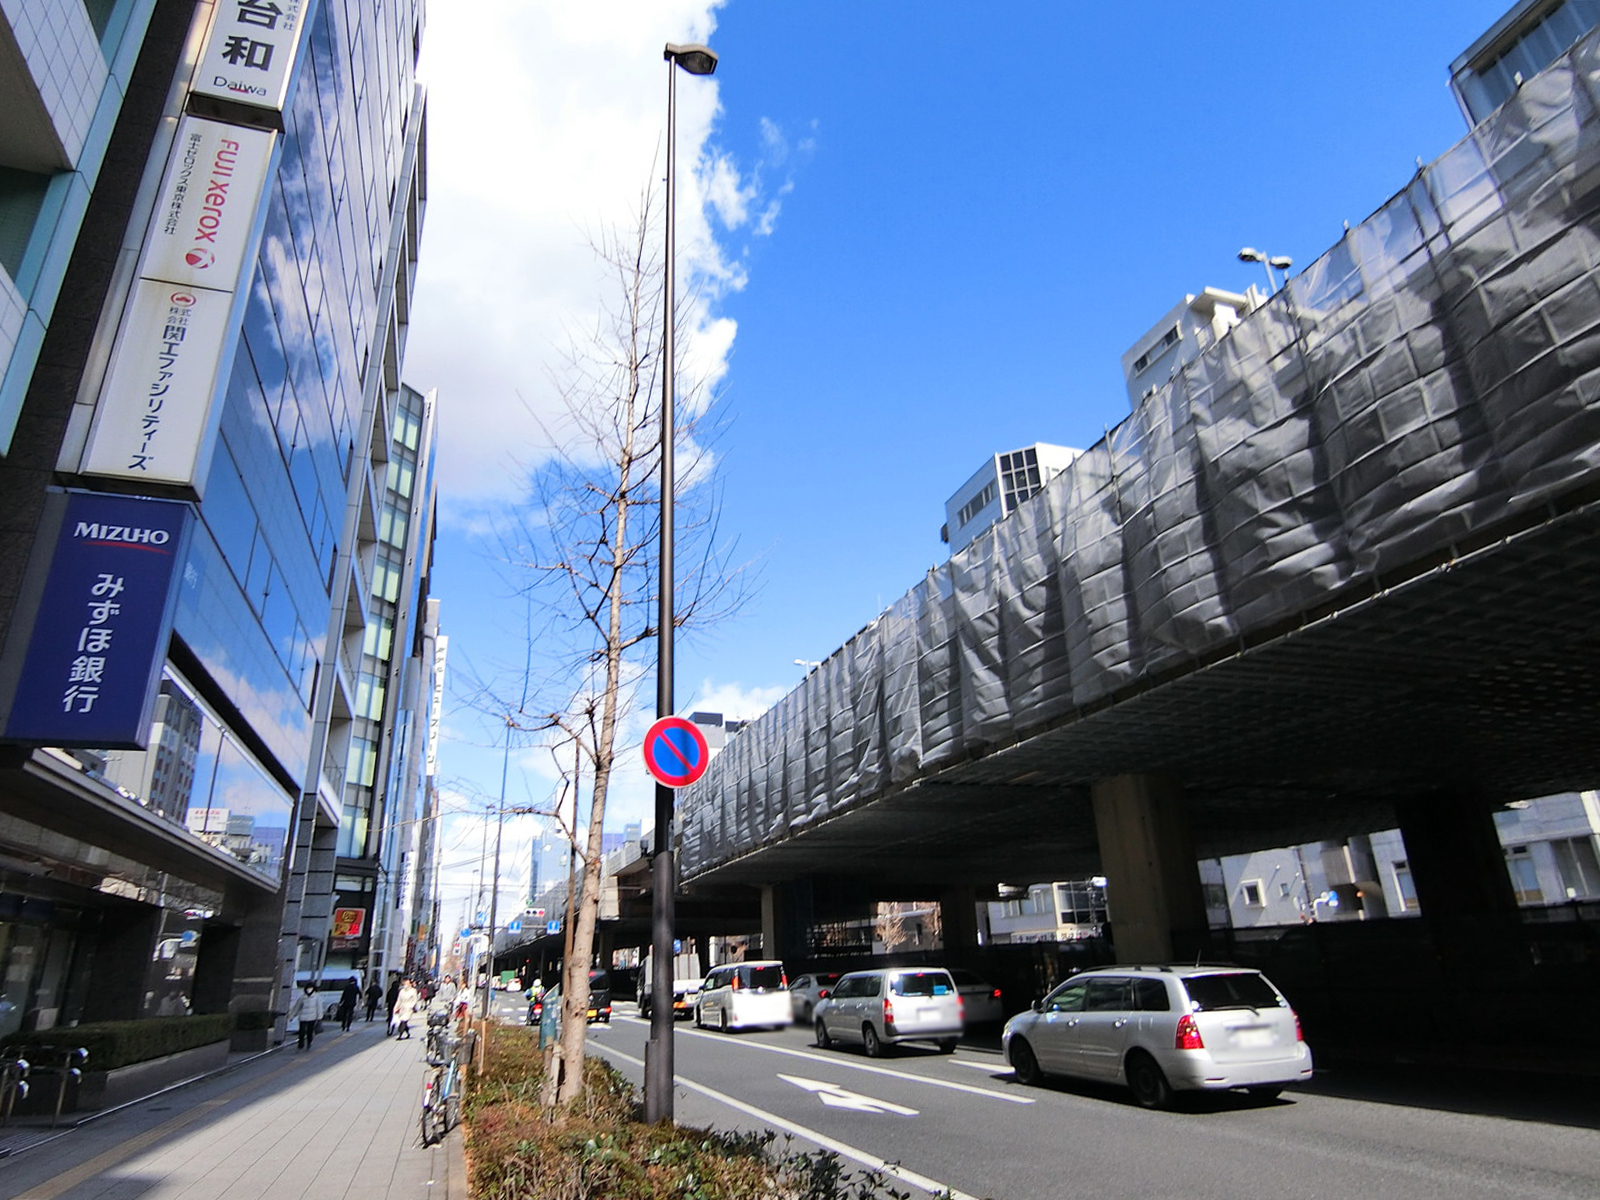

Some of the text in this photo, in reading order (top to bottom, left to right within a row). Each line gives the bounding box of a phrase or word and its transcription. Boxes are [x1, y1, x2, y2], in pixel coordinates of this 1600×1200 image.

[213, 76, 267, 96] Daiwa
[212, 138, 239, 177] FUJI
[73, 521, 170, 545] MIZUHO
[63, 573, 125, 713] みずほ銀行
